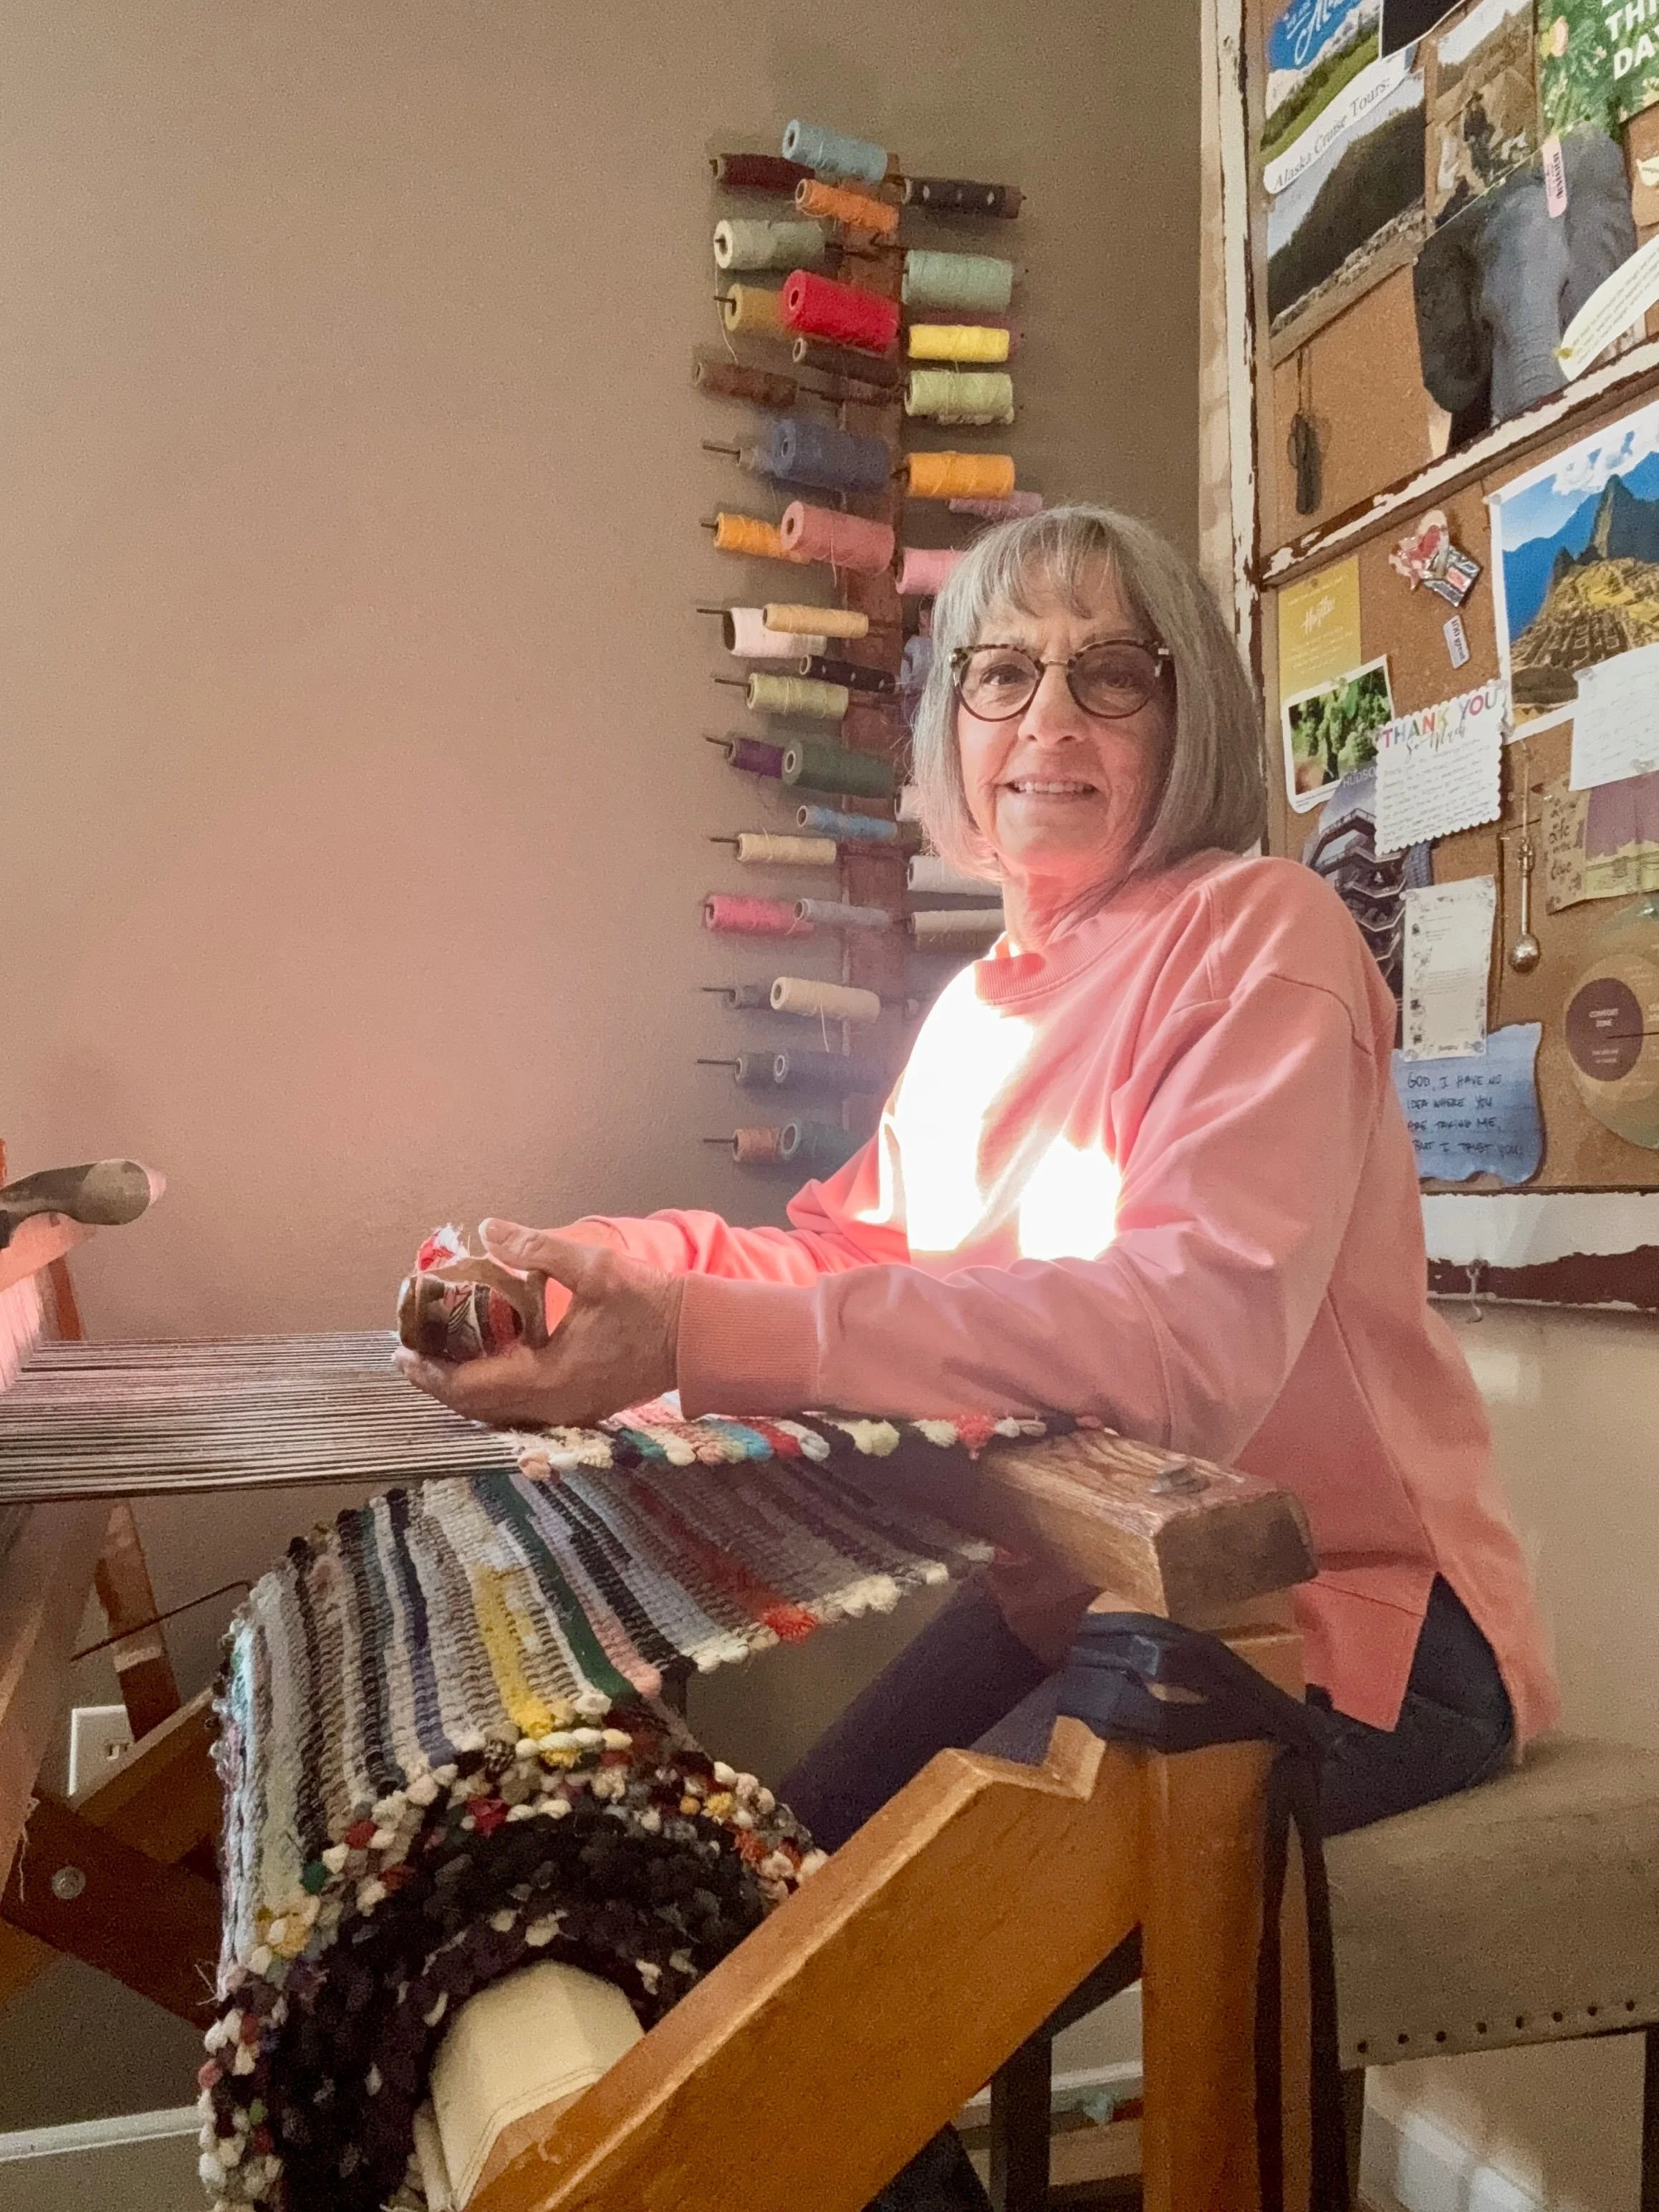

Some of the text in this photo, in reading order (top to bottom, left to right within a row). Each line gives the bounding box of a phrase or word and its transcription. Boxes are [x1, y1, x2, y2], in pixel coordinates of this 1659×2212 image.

[1273, 77, 1390, 191] Alaska Cruise Tours:
[1382, 688, 1499, 749] THANK YOU
[1439, 1076, 1449, 1089] I
[1456, 1074, 1484, 1088] HAVE
[1489, 1074, 1502, 1085] NO
[1407, 1095, 1493, 1110] IDEA WHERE YOU
[1407, 1120, 1428, 1131] ARE
[1433, 1120, 1472, 1129] TAKING
[1412, 1139, 1436, 1152] BUT
[1439, 1142, 1451, 1153] I
[1456, 1142, 1493, 1153] TRUST
